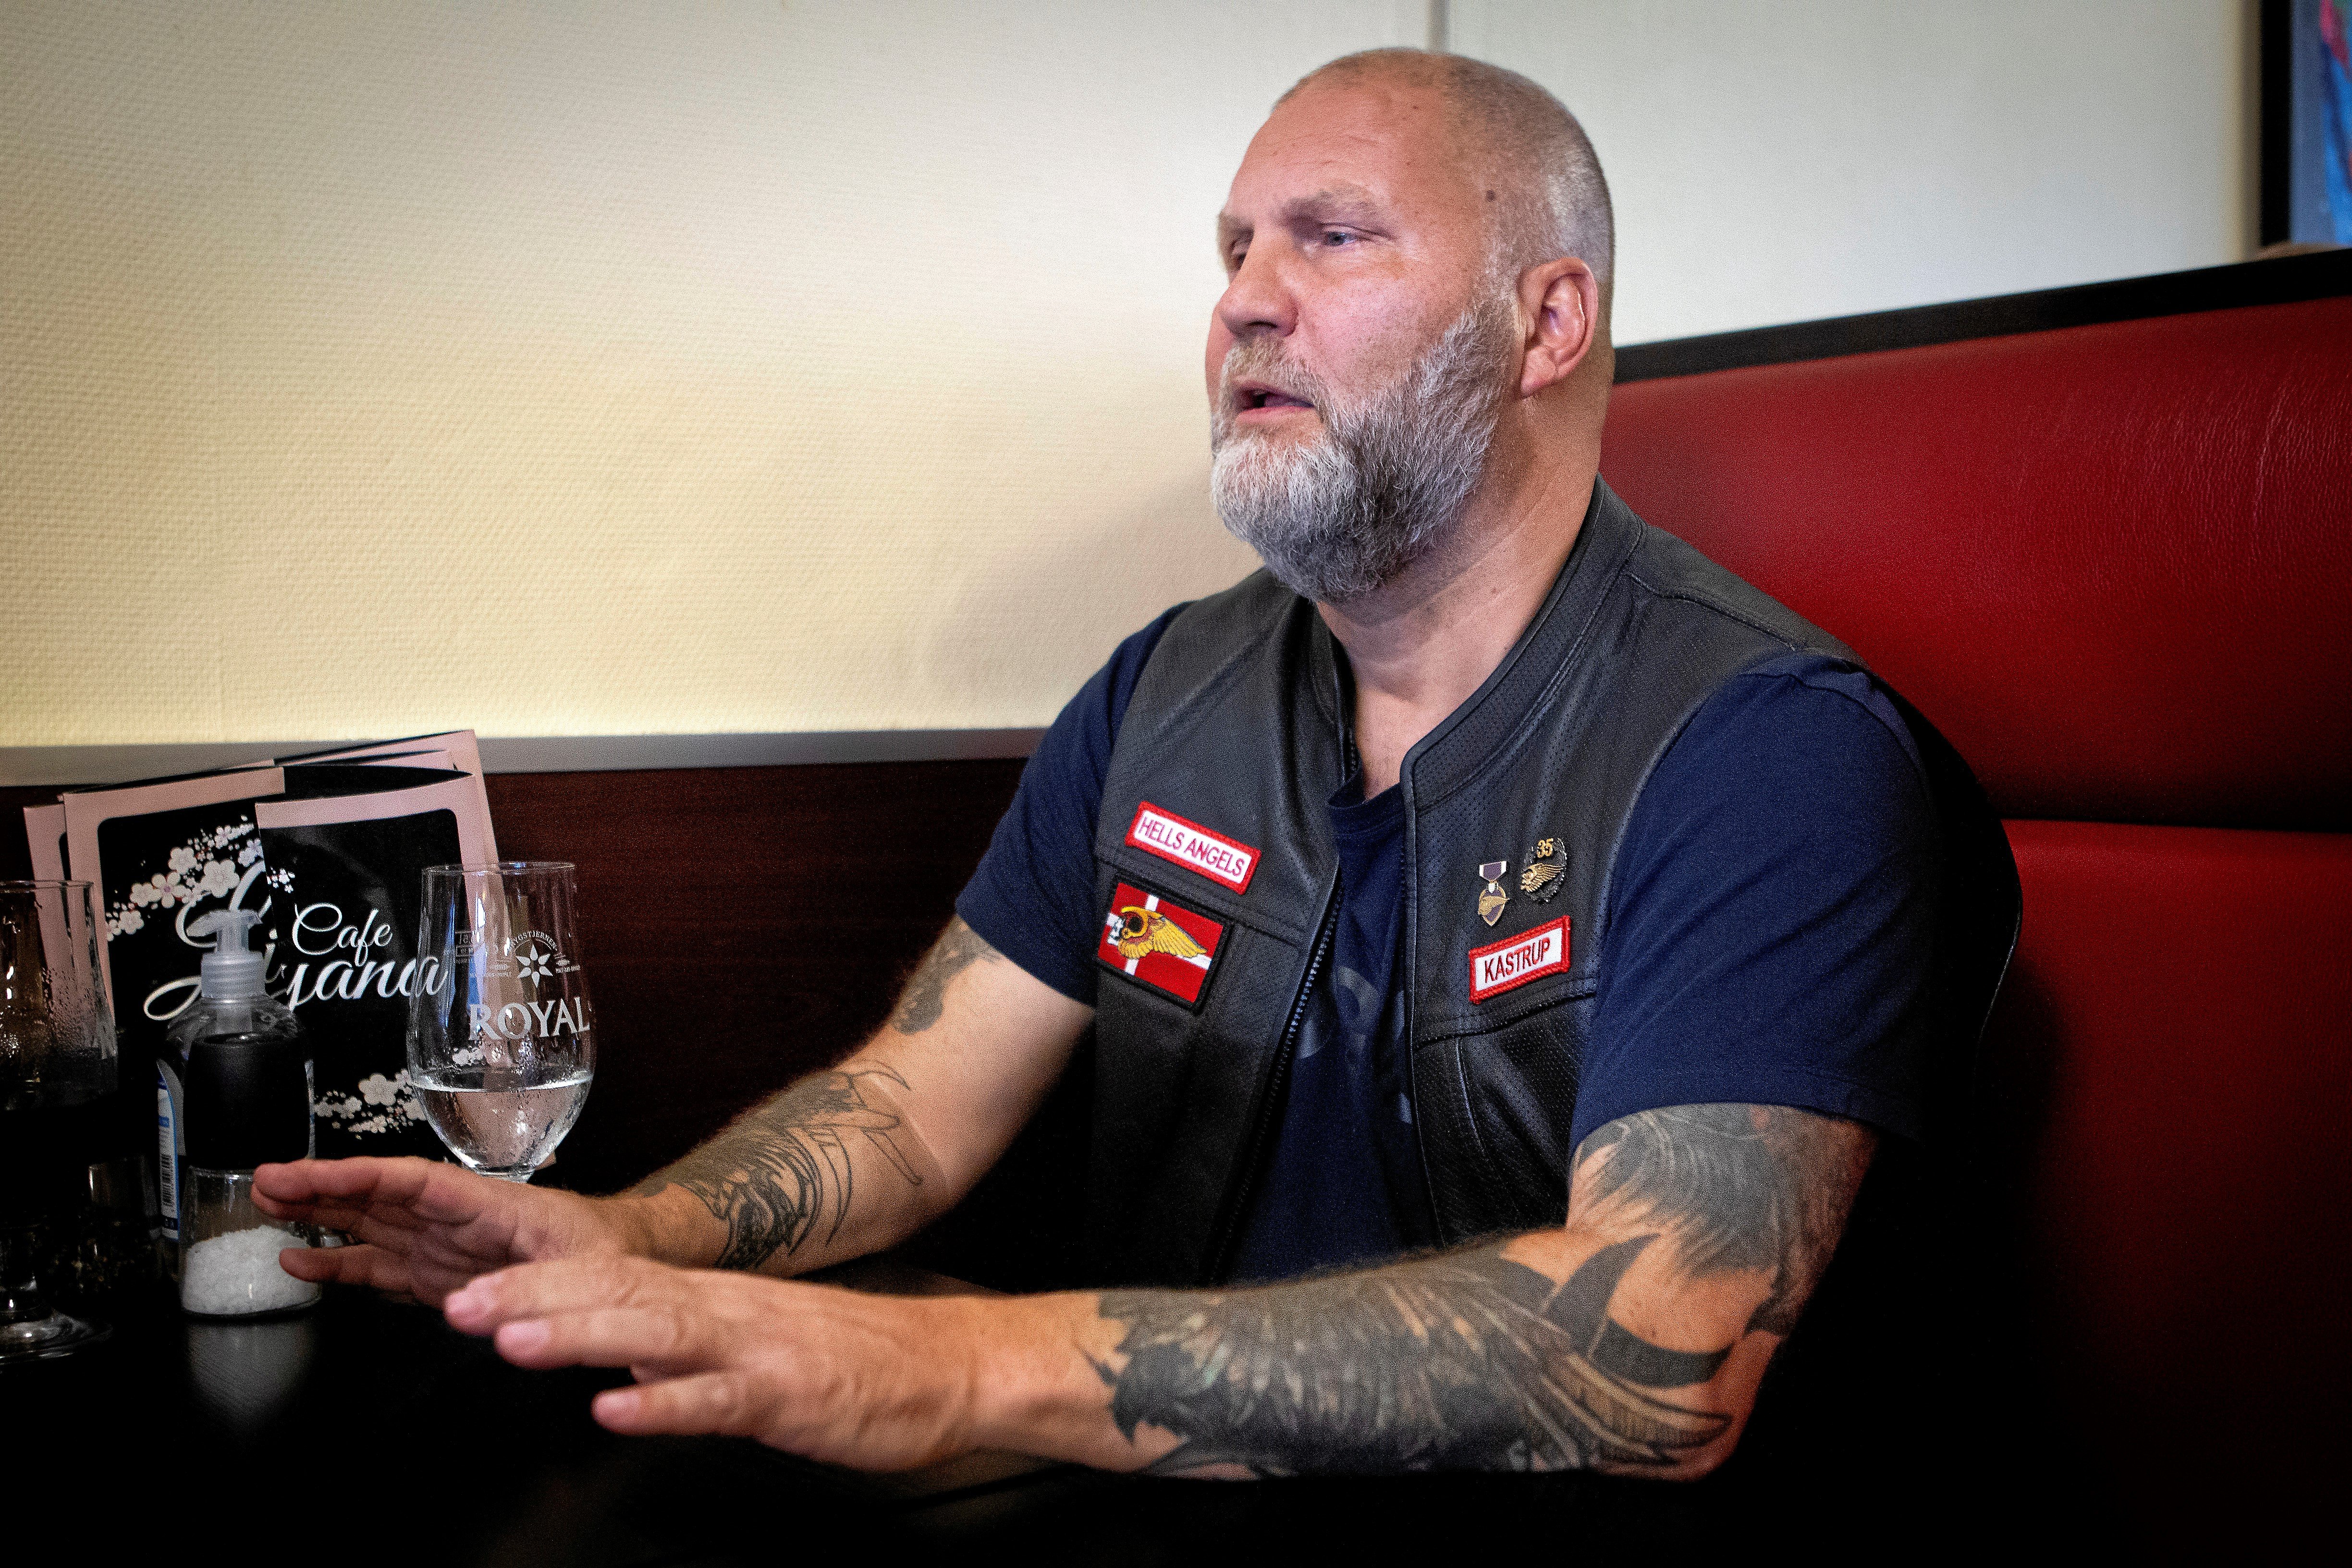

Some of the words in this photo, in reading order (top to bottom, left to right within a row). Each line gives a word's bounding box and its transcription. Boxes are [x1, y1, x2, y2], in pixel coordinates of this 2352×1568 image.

[1138, 816, 1185, 850] HELLS
[1183, 838, 1245, 877] ANGELS
[1537, 838, 1554, 858] 35
[292, 902, 392, 966] Cafe
[1484, 937, 1551, 983] KASTRUP
[468, 997, 590, 1041] ROYAL
